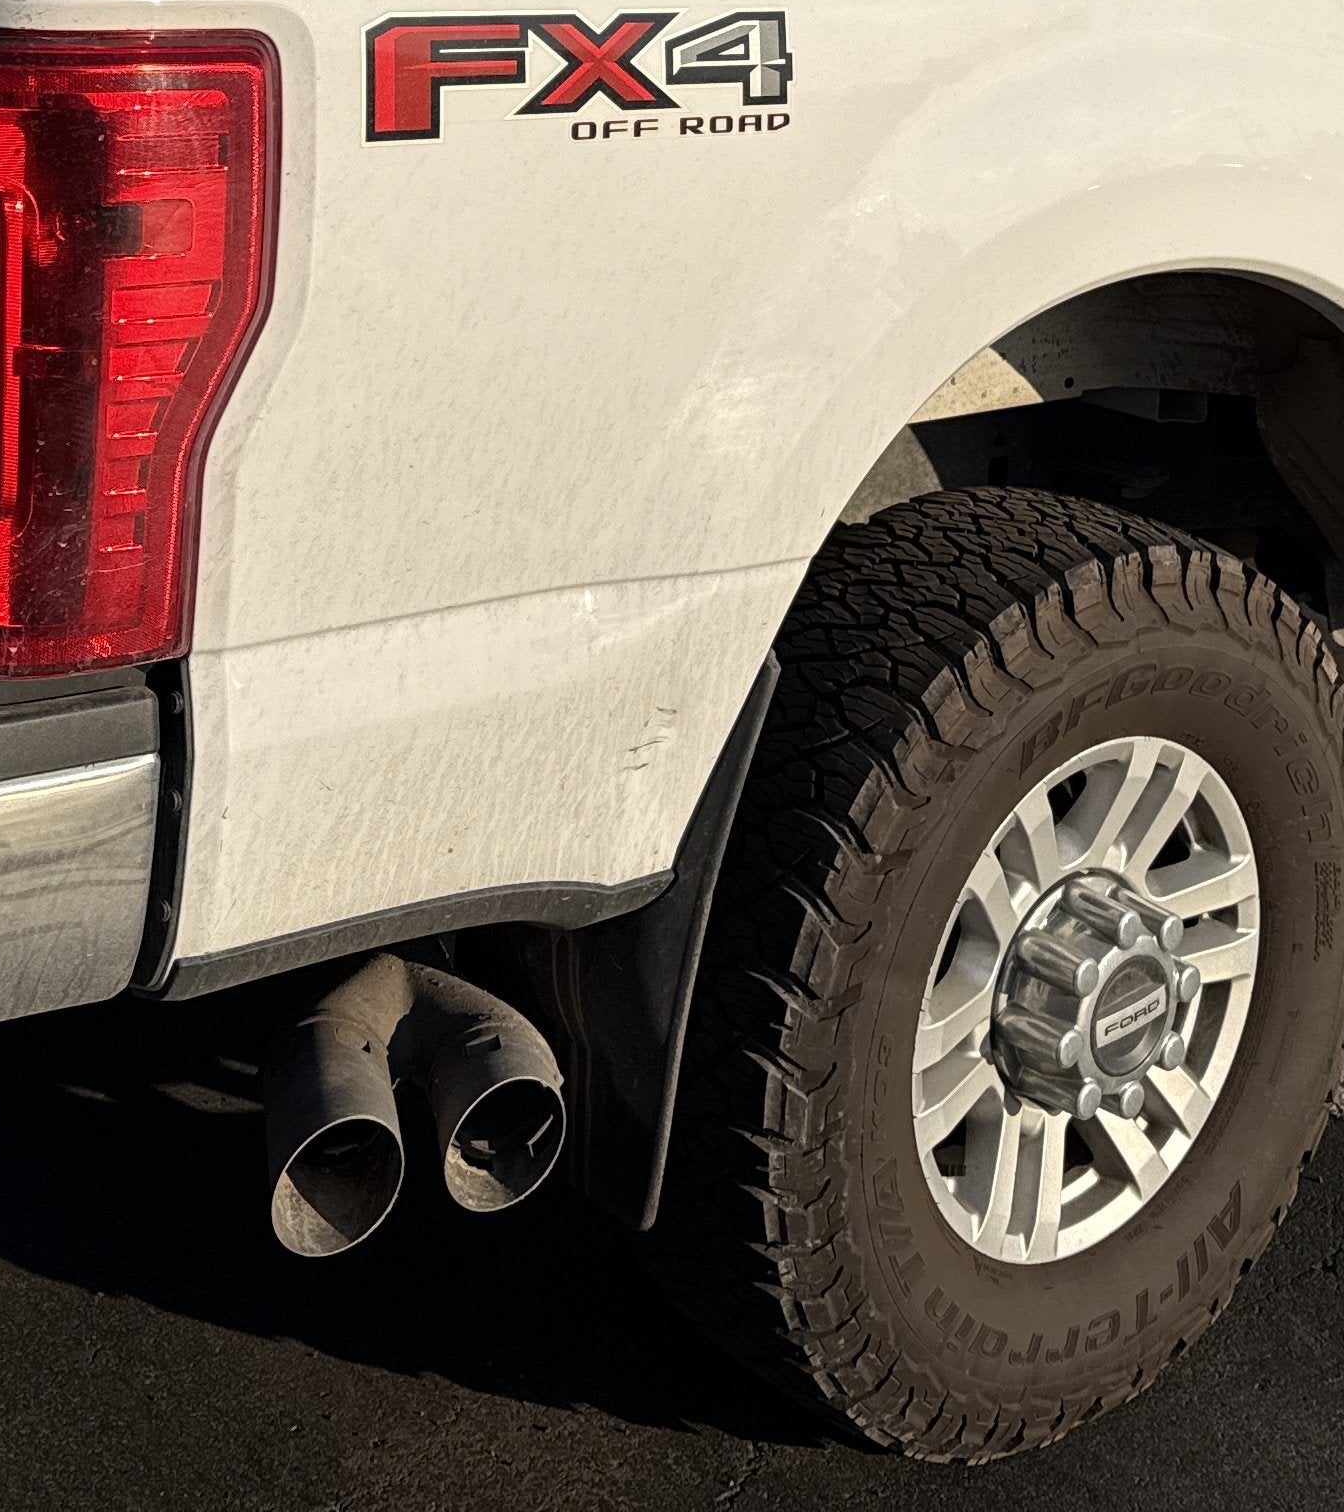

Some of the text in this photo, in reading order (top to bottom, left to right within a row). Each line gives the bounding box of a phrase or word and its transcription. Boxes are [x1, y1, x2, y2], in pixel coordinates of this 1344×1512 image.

[364, 9, 794, 144] FX4
[570, 112, 791, 141] OFF ROAD
[1104, 998, 1160, 1037] FORD
